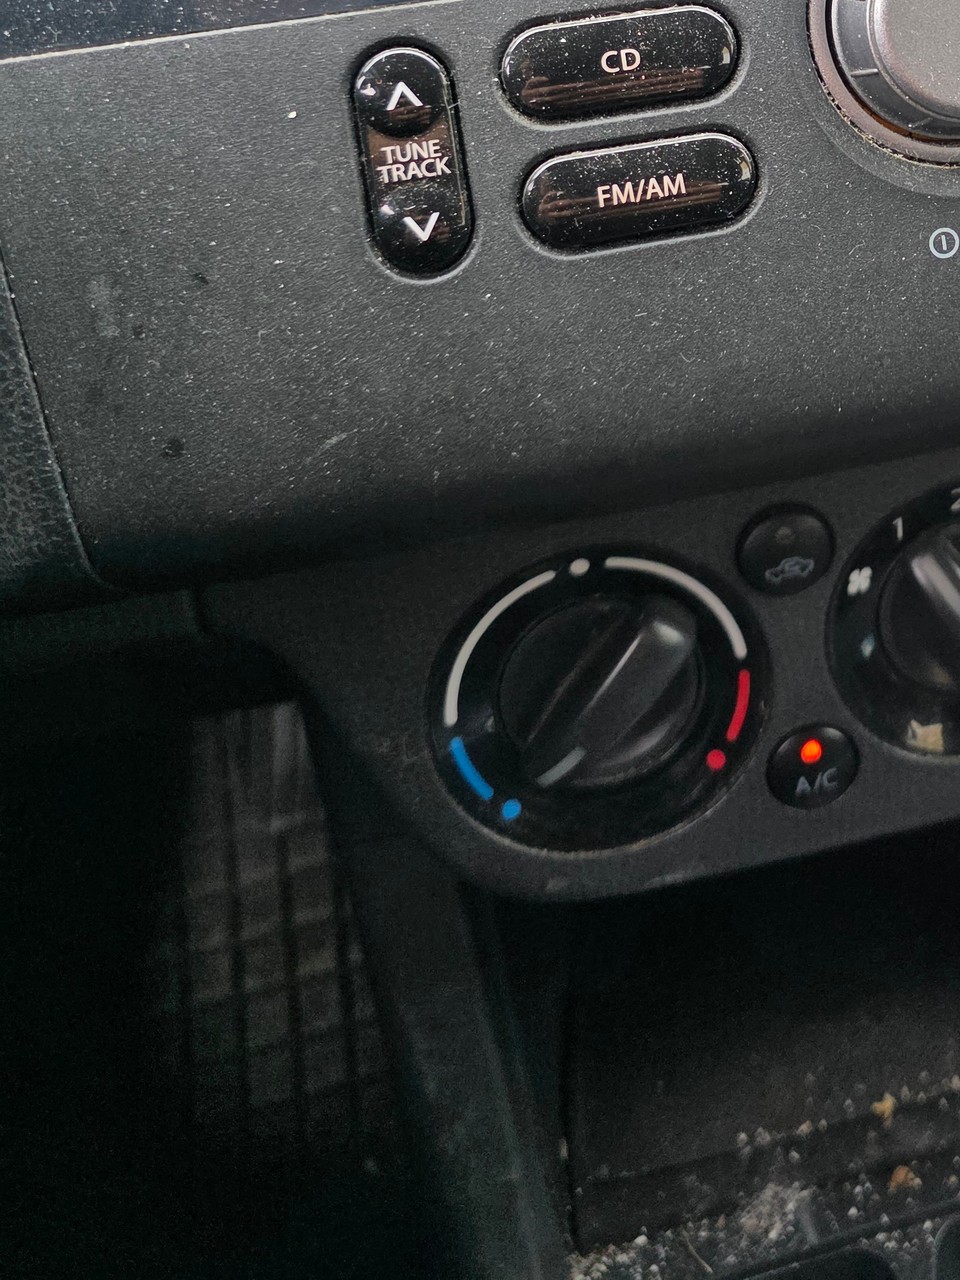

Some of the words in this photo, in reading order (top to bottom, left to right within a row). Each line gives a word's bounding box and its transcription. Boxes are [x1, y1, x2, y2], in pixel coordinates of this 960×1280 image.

[601, 48, 641, 74] CD
[380, 139, 442, 163] TUNE
[376, 156, 451, 184] TRACK
[597, 173, 687, 208] FM/AM
[892, 517, 903, 541] 1
[796, 768, 840, 797] A/C
